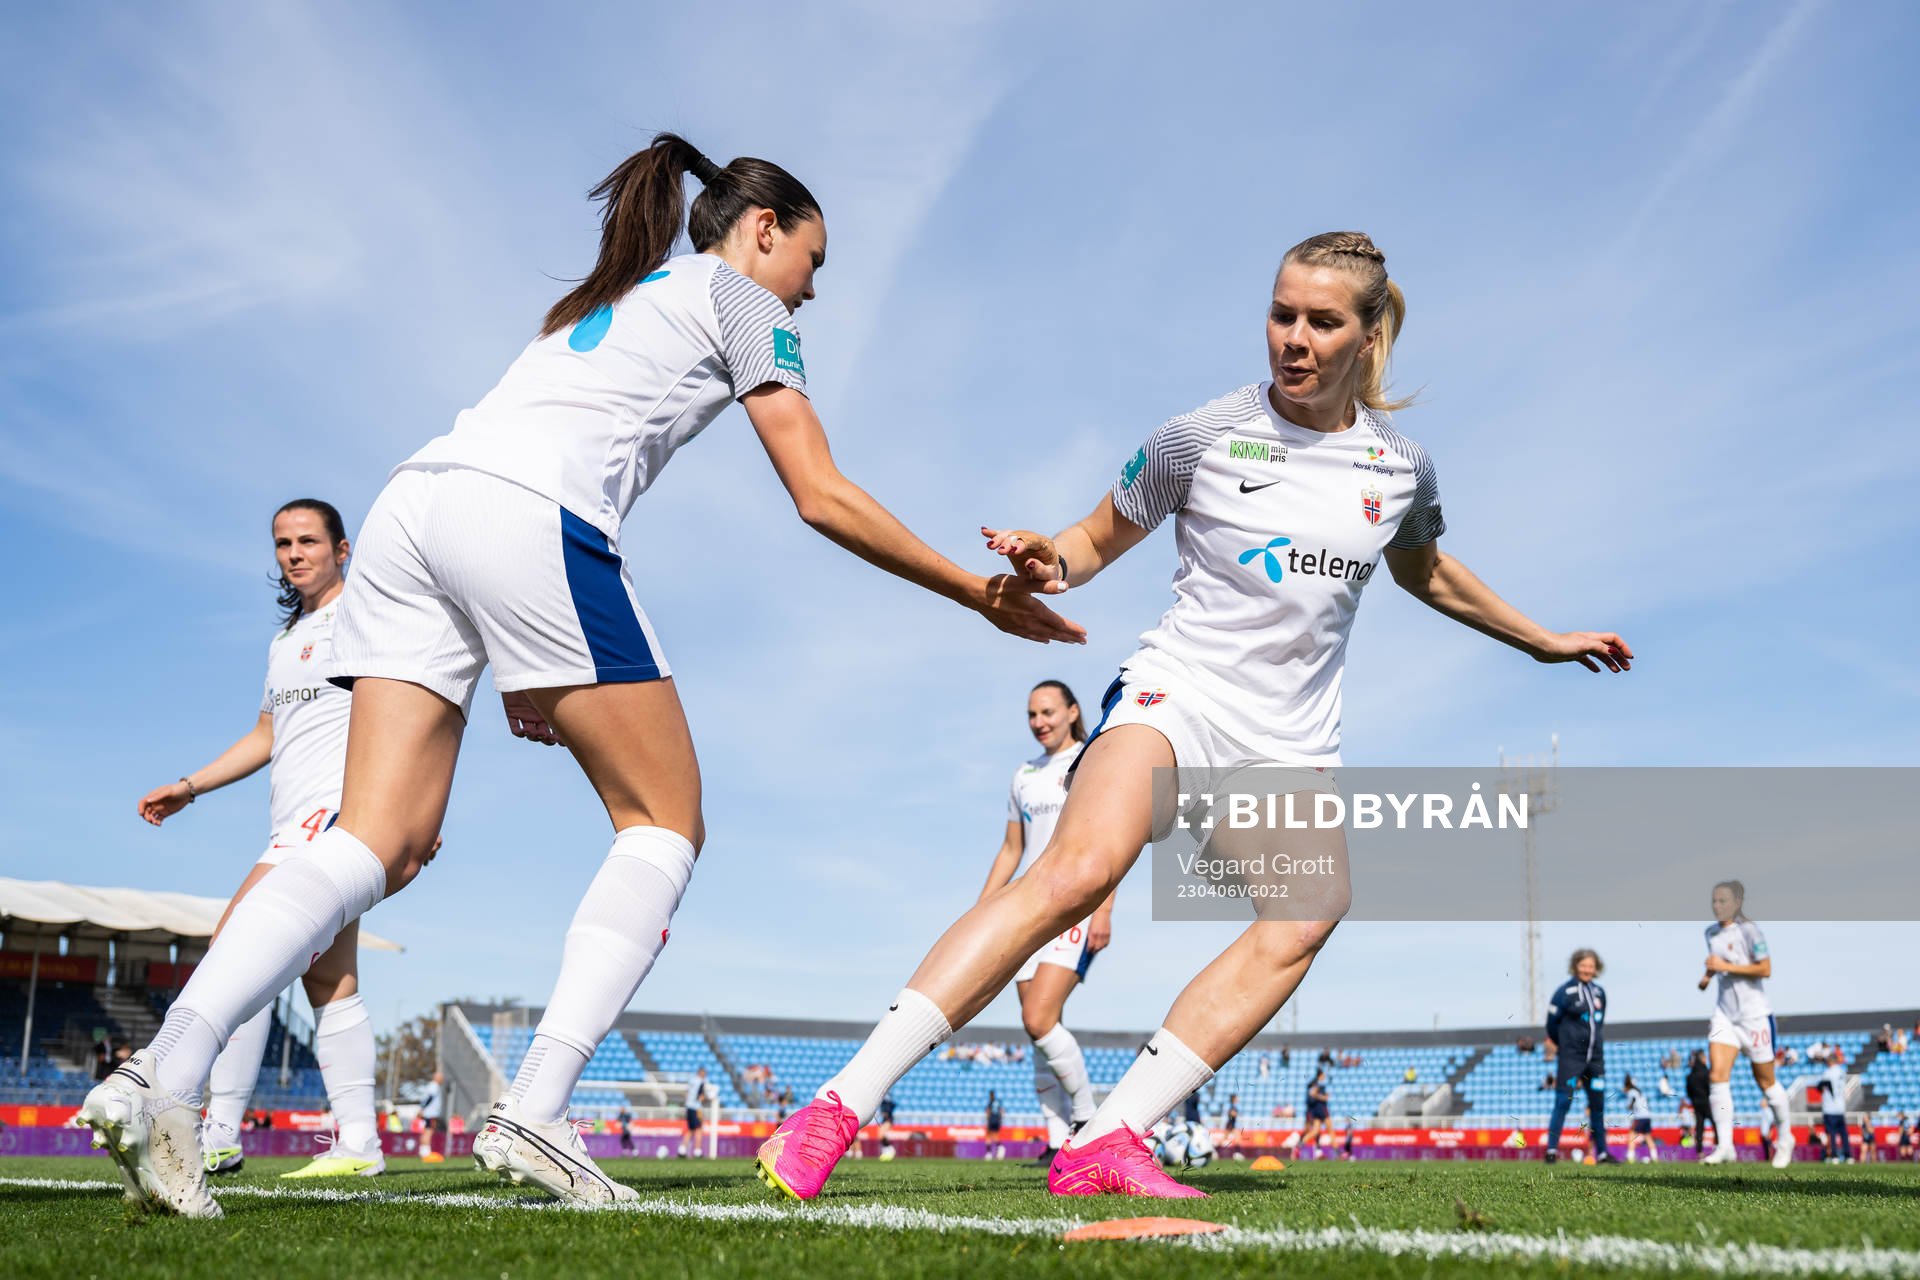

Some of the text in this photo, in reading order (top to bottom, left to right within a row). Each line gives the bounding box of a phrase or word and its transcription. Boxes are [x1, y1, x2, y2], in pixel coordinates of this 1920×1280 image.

[1230, 440, 1269, 461] KIWI
[1270, 453, 1286, 463] pris
[1271, 445, 1288, 454] mini
[1352, 461, 1395, 477] Norsk Tipping
[275, 687, 320, 706] elenor
[301, 808, 327, 842] 4
[1060, 926, 1082, 944] 0
